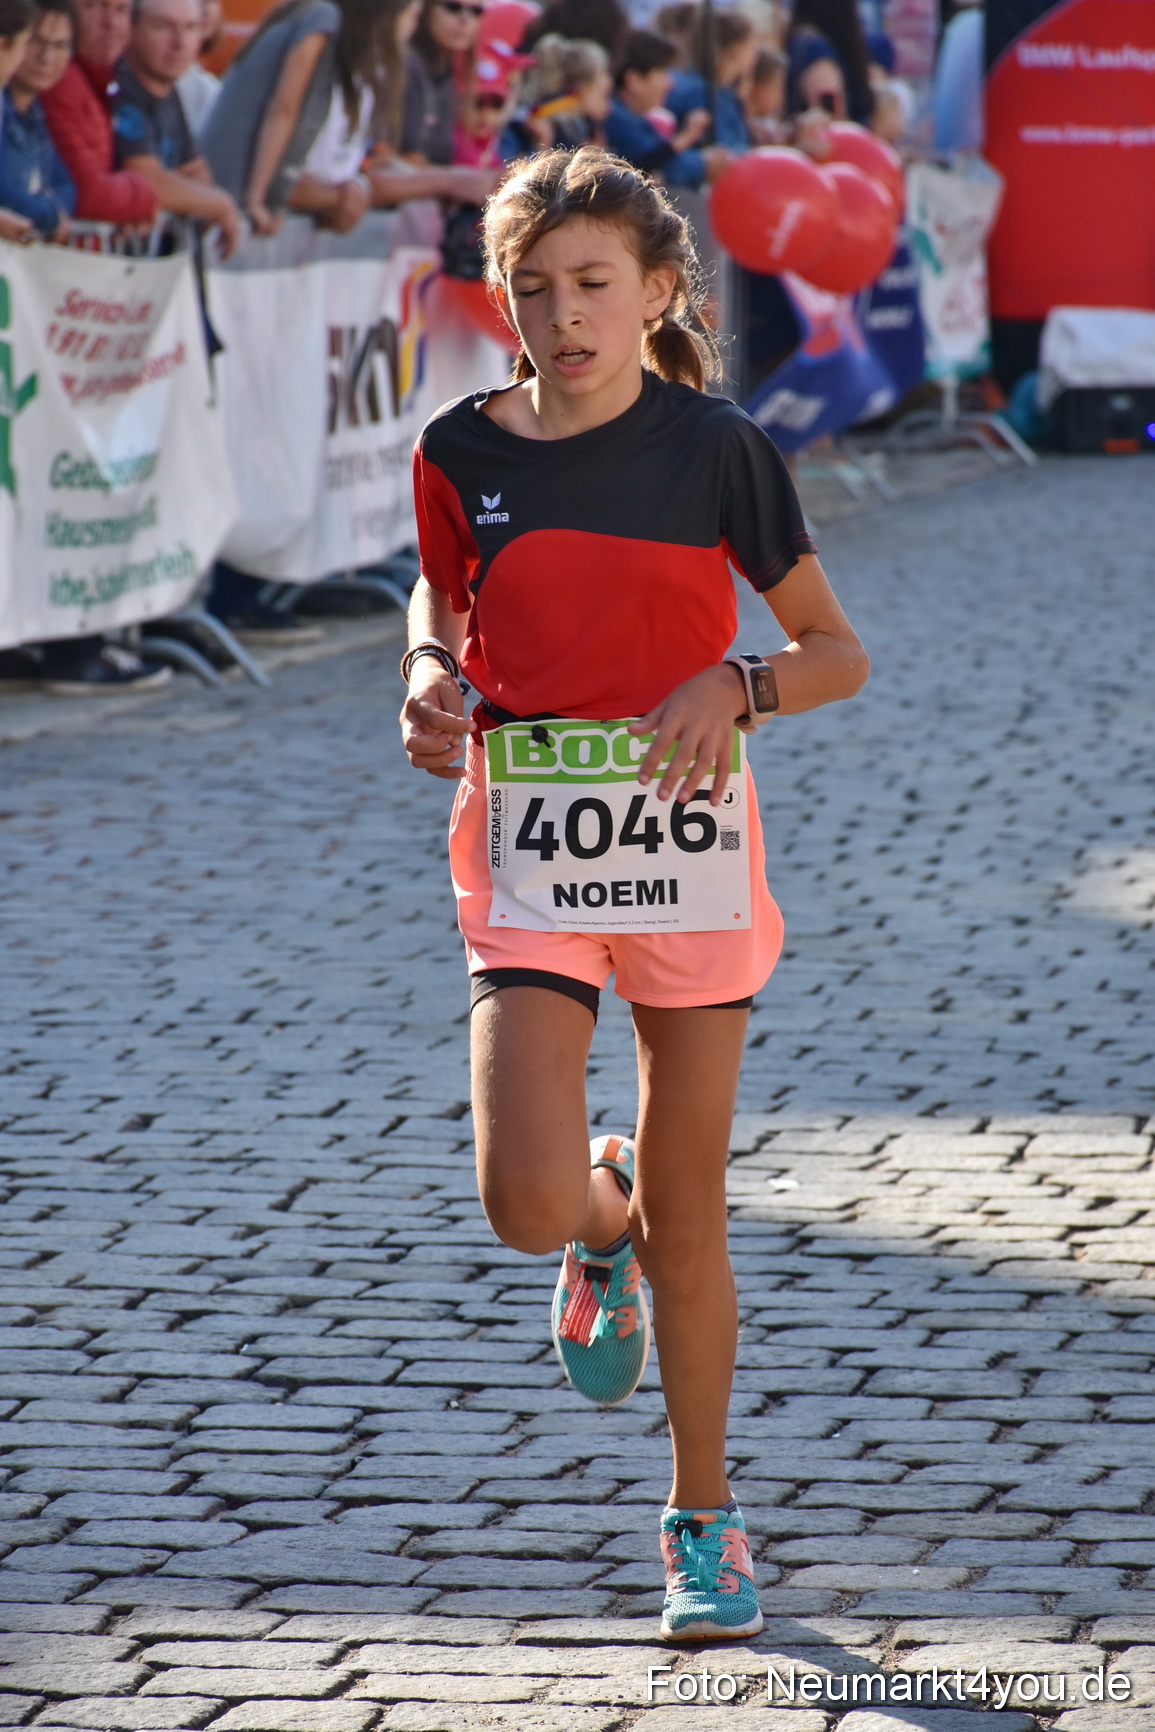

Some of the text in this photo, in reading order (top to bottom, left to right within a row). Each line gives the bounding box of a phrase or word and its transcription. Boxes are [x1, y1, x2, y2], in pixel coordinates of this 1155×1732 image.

[476, 511, 510, 525] erima
[503, 728, 720, 776] BOC
[723, 792, 734, 804] J
[515, 789, 718, 862] 4046
[552, 878, 679, 908] NOEMI
